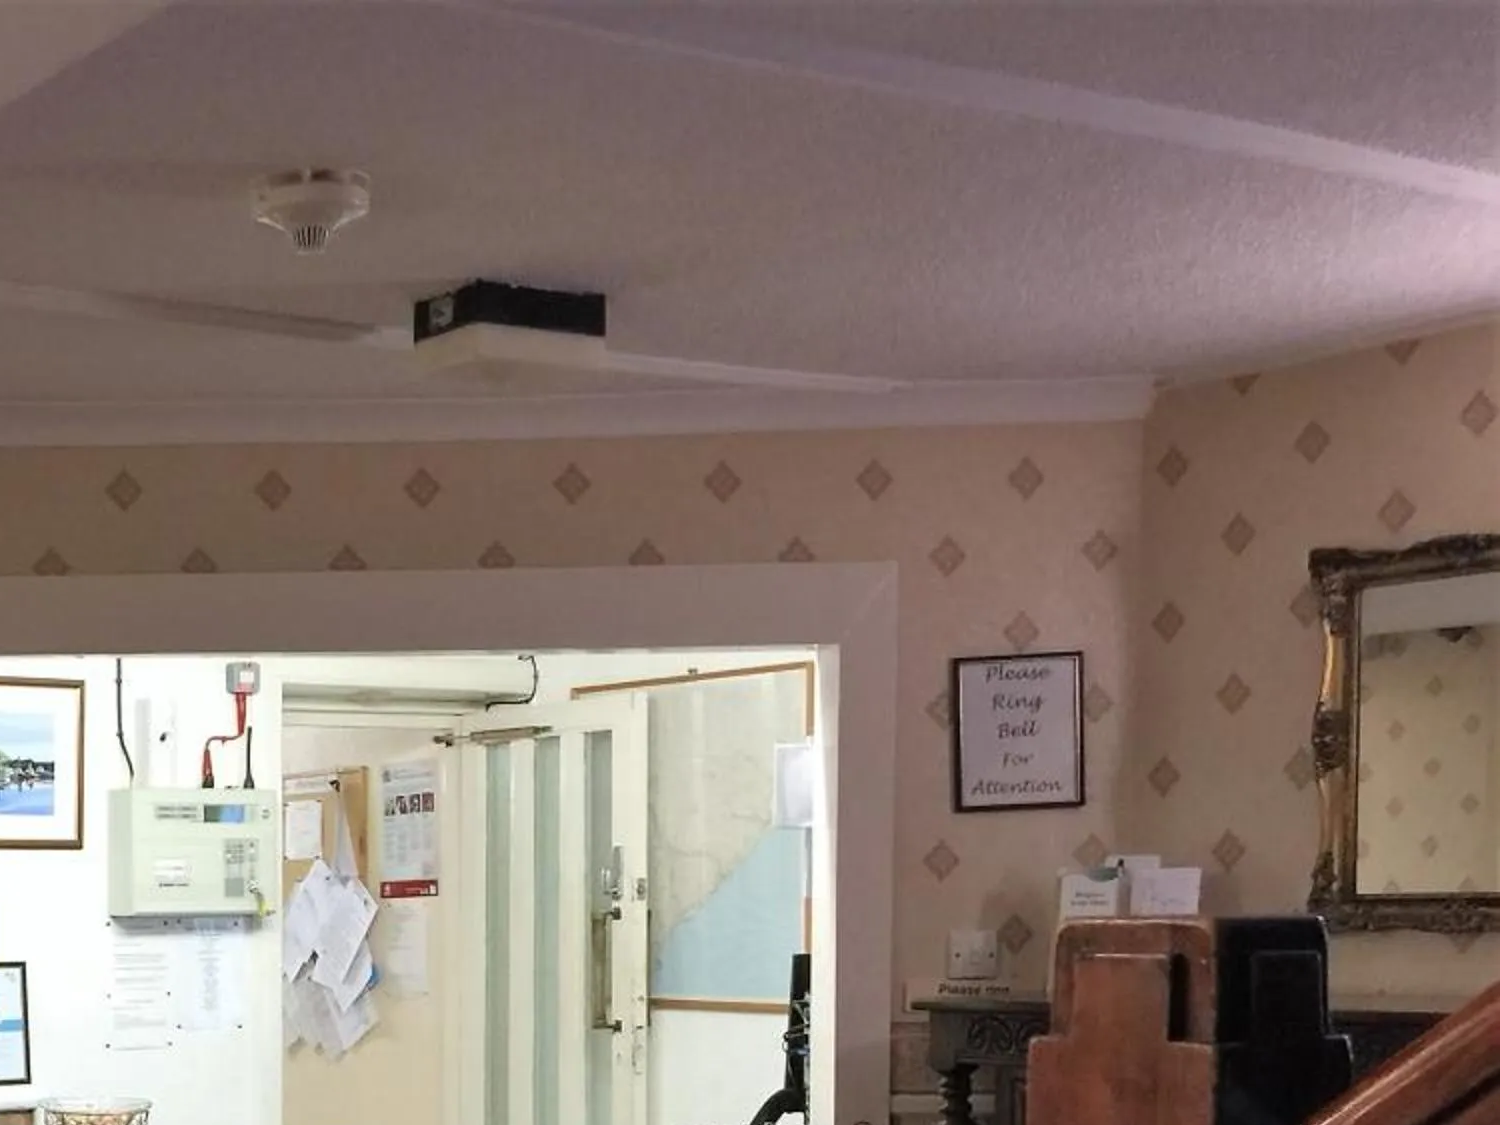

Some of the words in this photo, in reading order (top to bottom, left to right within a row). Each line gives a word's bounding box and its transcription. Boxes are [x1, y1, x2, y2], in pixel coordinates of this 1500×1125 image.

[986, 664, 1052, 683] Please
[992, 693, 1044, 714] Ring
[997, 719, 1040, 739] Bell
[1002, 752, 1035, 768] For
[971, 778, 1062, 796] Attention
